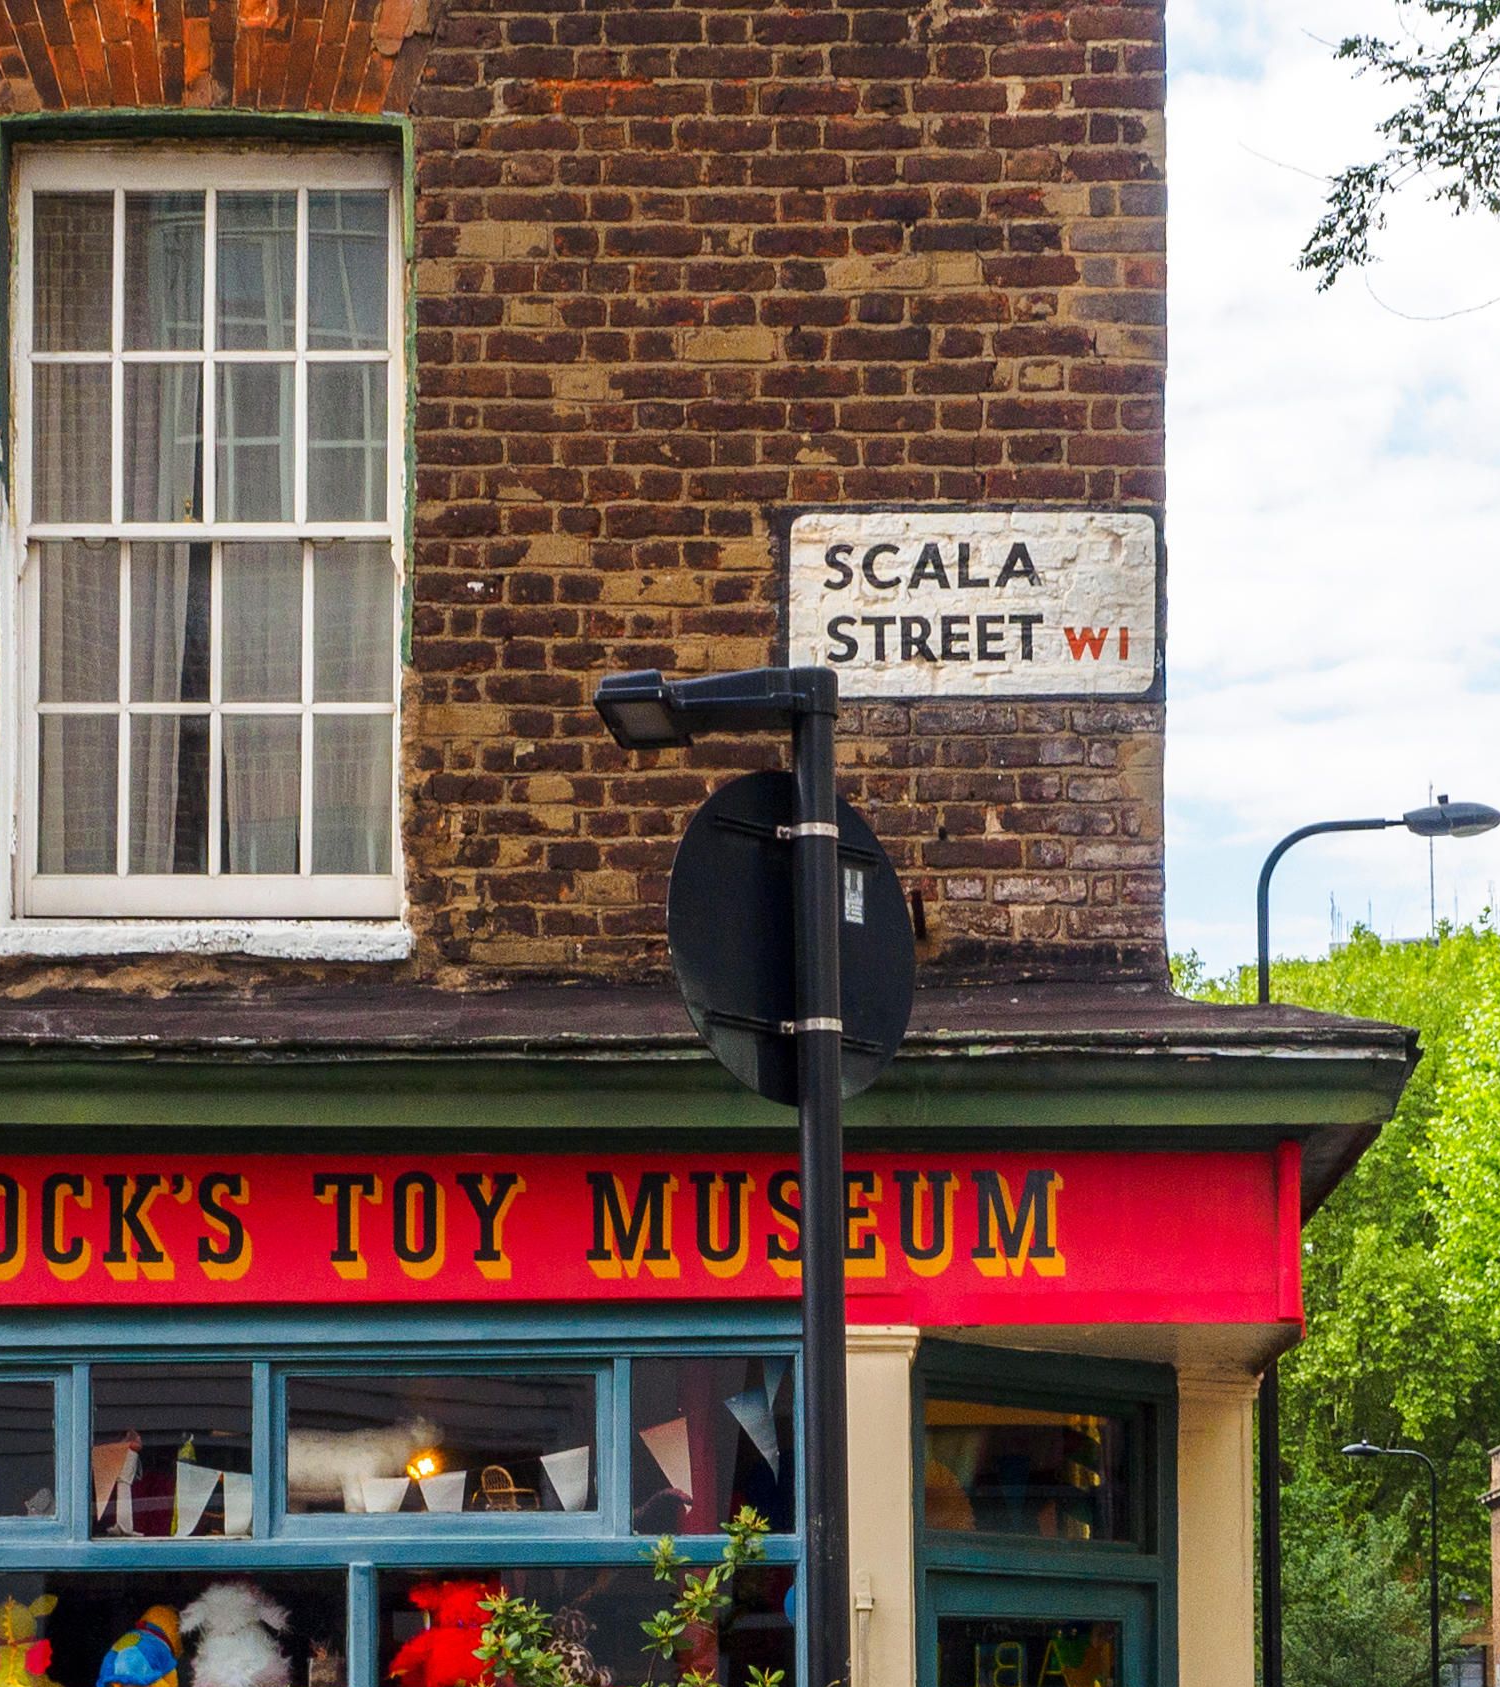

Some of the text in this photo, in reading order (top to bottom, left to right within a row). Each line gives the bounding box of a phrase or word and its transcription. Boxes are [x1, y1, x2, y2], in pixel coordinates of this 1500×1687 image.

[823, 542, 1043, 590] SCALA
[827, 614, 1044, 662] STREET
[313, 1171, 526, 1281] TOY
[586, 1169, 1066, 1279] MUSEUM
